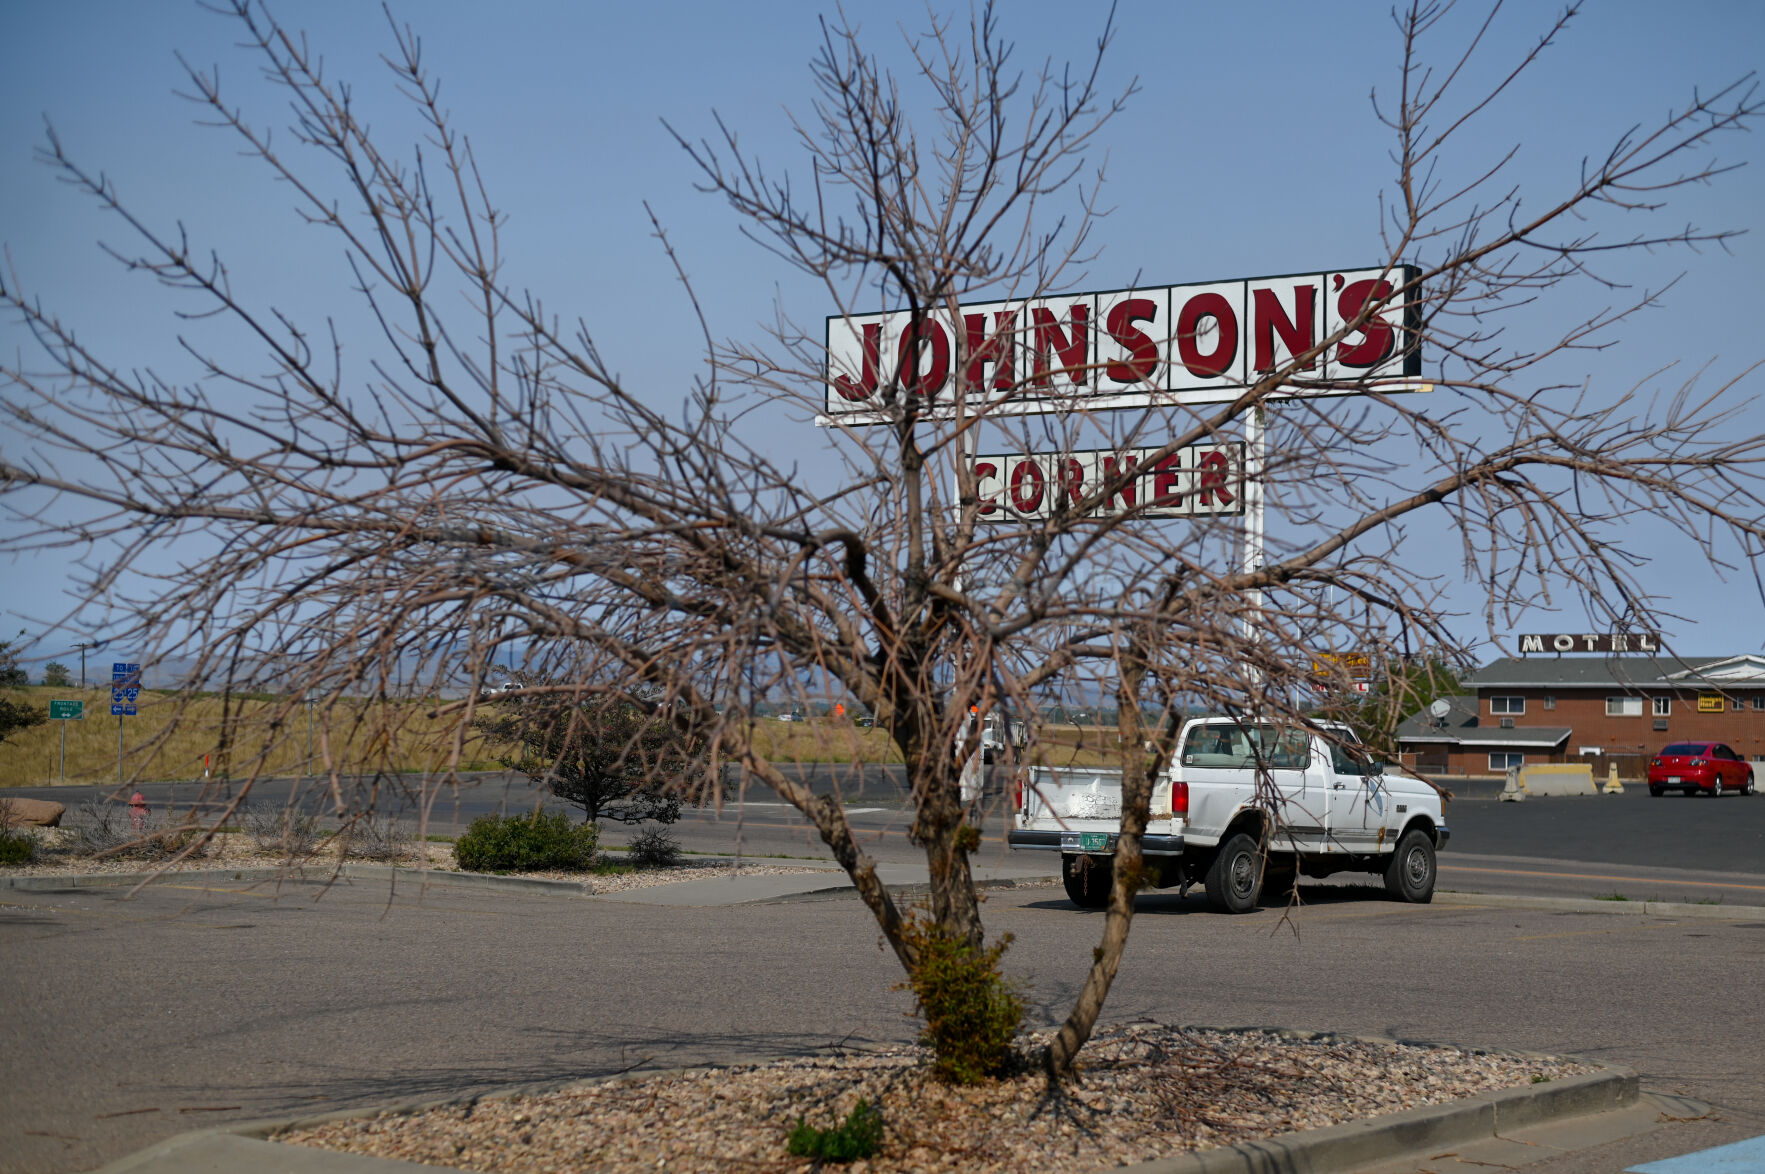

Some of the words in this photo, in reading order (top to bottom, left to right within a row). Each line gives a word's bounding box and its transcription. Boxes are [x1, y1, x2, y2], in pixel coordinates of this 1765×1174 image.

[834, 273, 1395, 402] JOHNSON'S
[972, 448, 1236, 515] CORNER
[1522, 635, 1656, 652] MOTEL
[127, 688, 138, 699] 25
